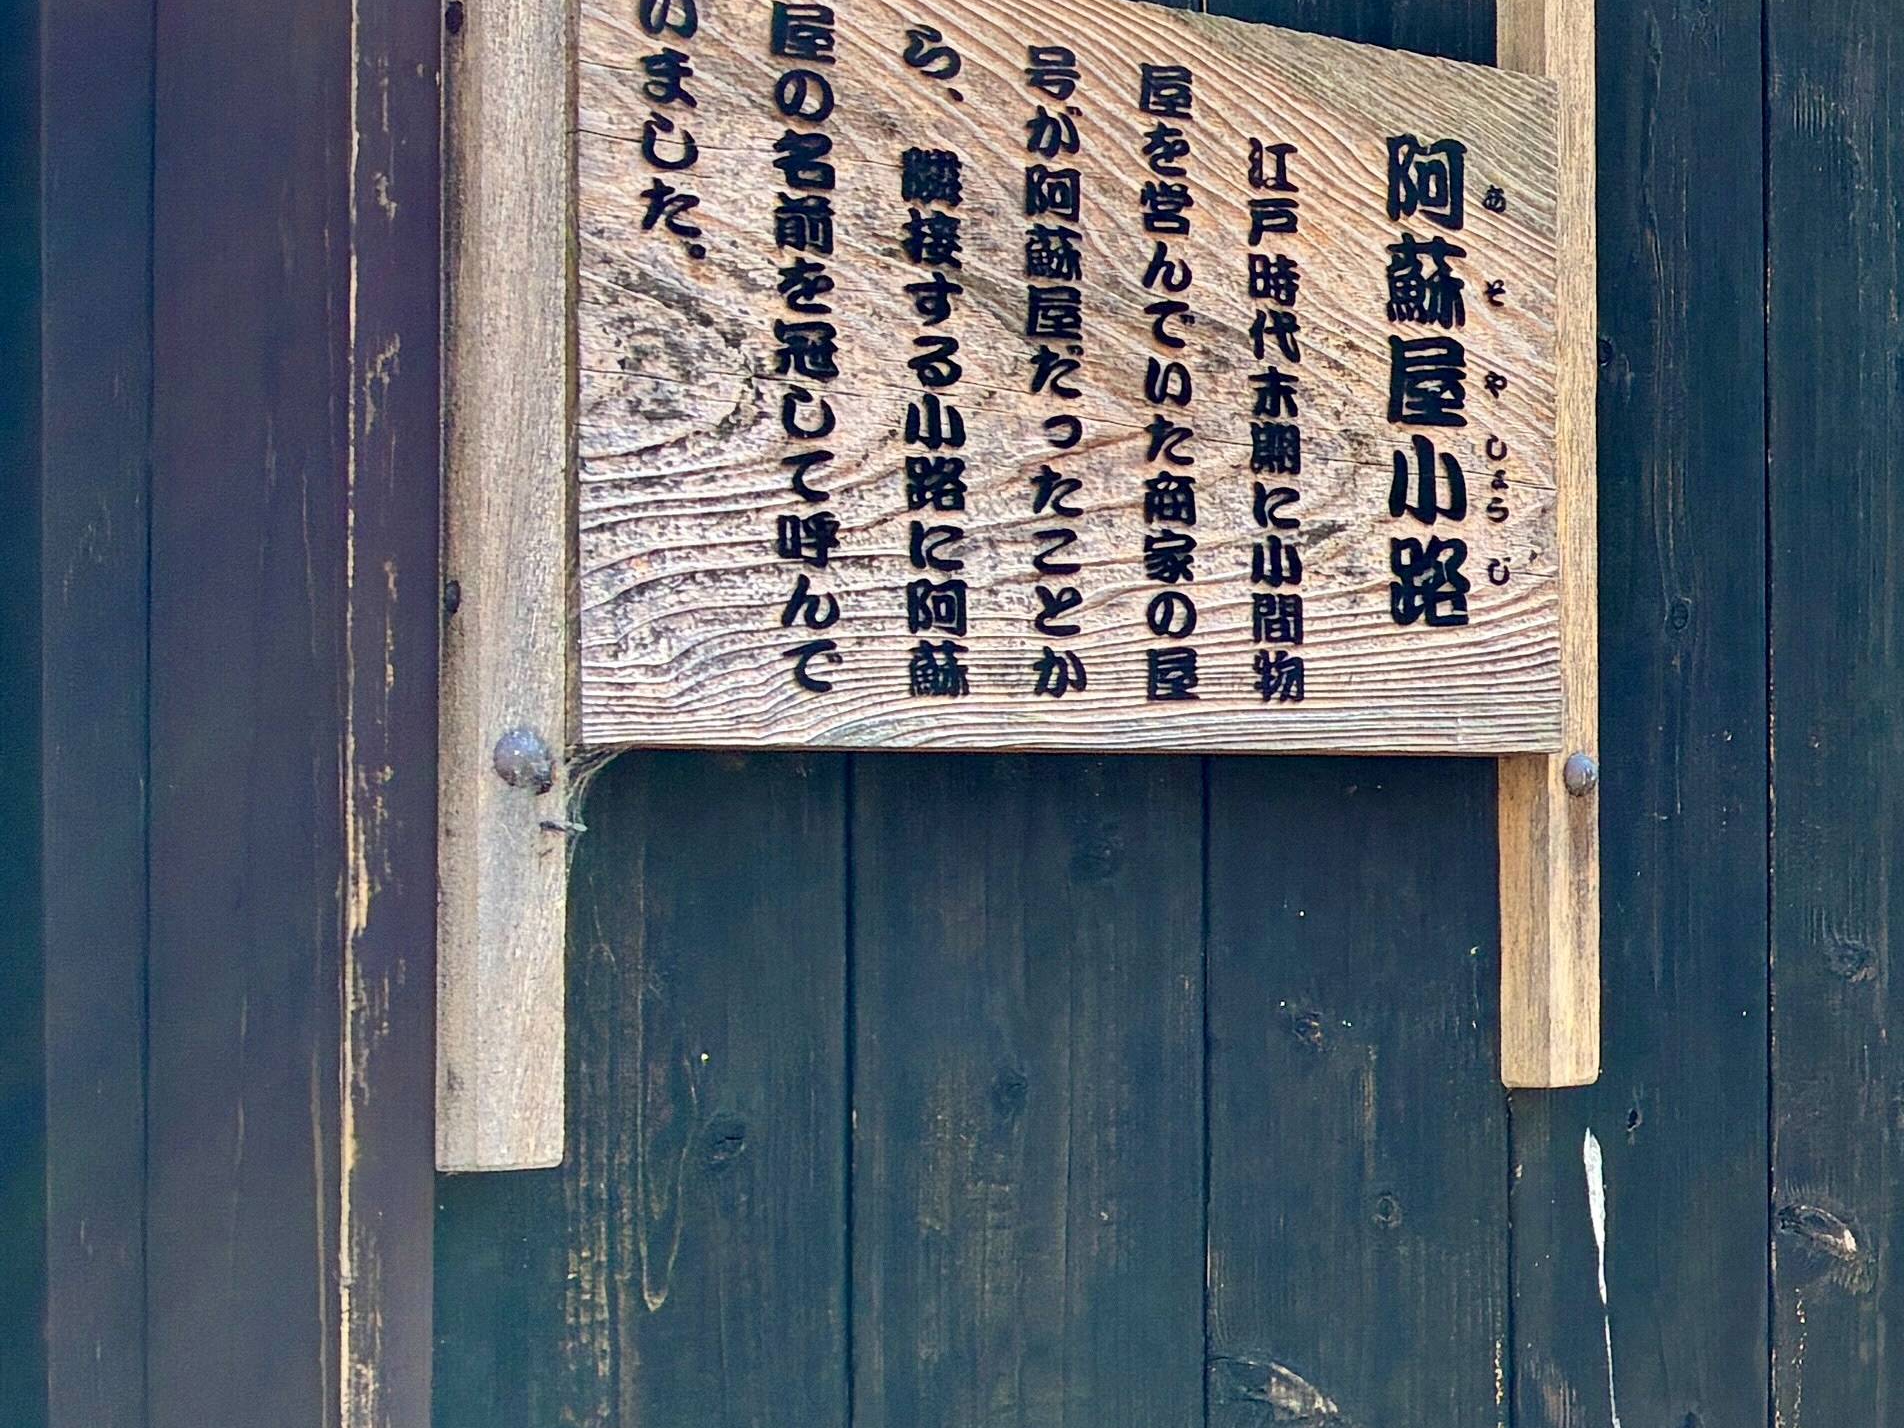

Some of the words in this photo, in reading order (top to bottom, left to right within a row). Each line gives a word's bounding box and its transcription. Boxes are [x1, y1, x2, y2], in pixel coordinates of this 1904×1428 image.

[770, 0, 841, 693] 屋の名前を冠して呼んで
[1023, 45, 1088, 698] 号が阿蘇屋だったことか
[1138, 62, 1199, 702] 屋を営んでいた商家の屋
[1247, 136, 1305, 704] 江戸時代末期に小間物
[1386, 133, 1471, 628] 阿蘇屋小路
